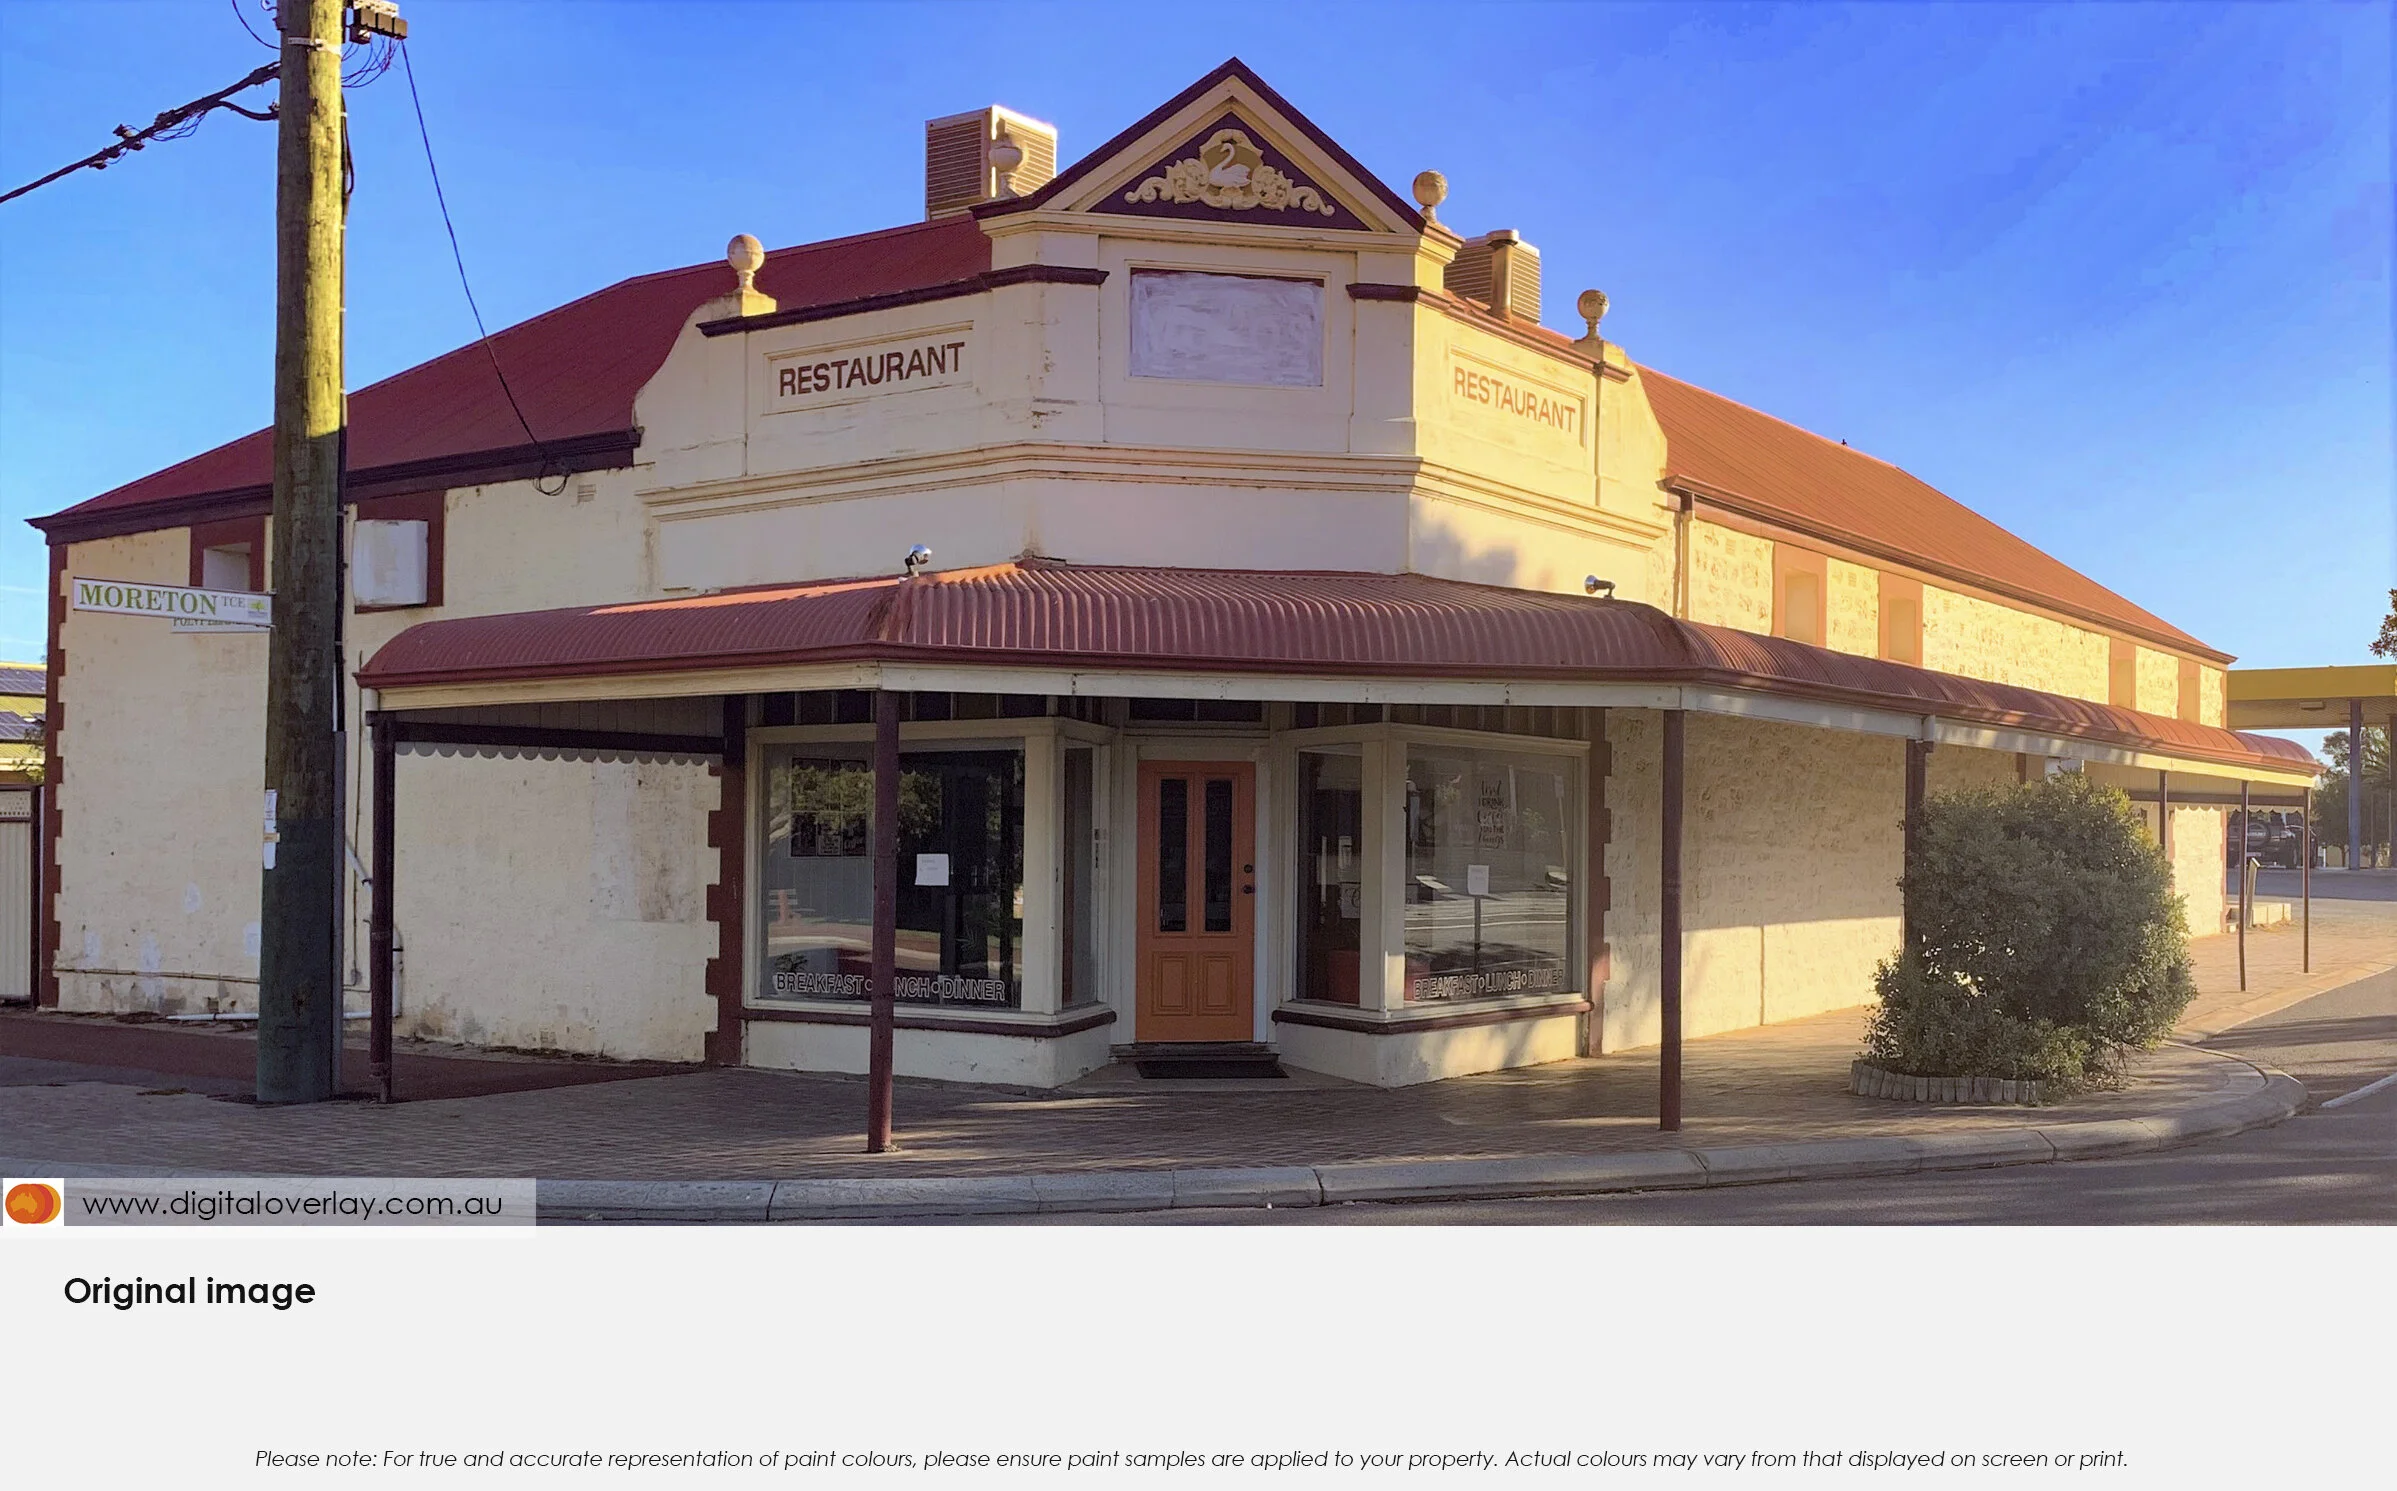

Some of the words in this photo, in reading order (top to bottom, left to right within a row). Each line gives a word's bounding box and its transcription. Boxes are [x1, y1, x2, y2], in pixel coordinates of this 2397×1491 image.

[779, 341, 966, 397] RESTAURANT
[1454, 366, 1576, 433] RESTAURANT
[79, 583, 218, 615] MORETON
[221, 595, 246, 609] TCE
[775, 972, 865, 995] BREAKFAST
[894, 976, 930, 998] NCH
[942, 975, 1006, 1001] DINNER
[1413, 974, 1478, 1000] BREAKFAST
[1485, 970, 1522, 992] LUNCH
[1528, 967, 1565, 989] DINNER
